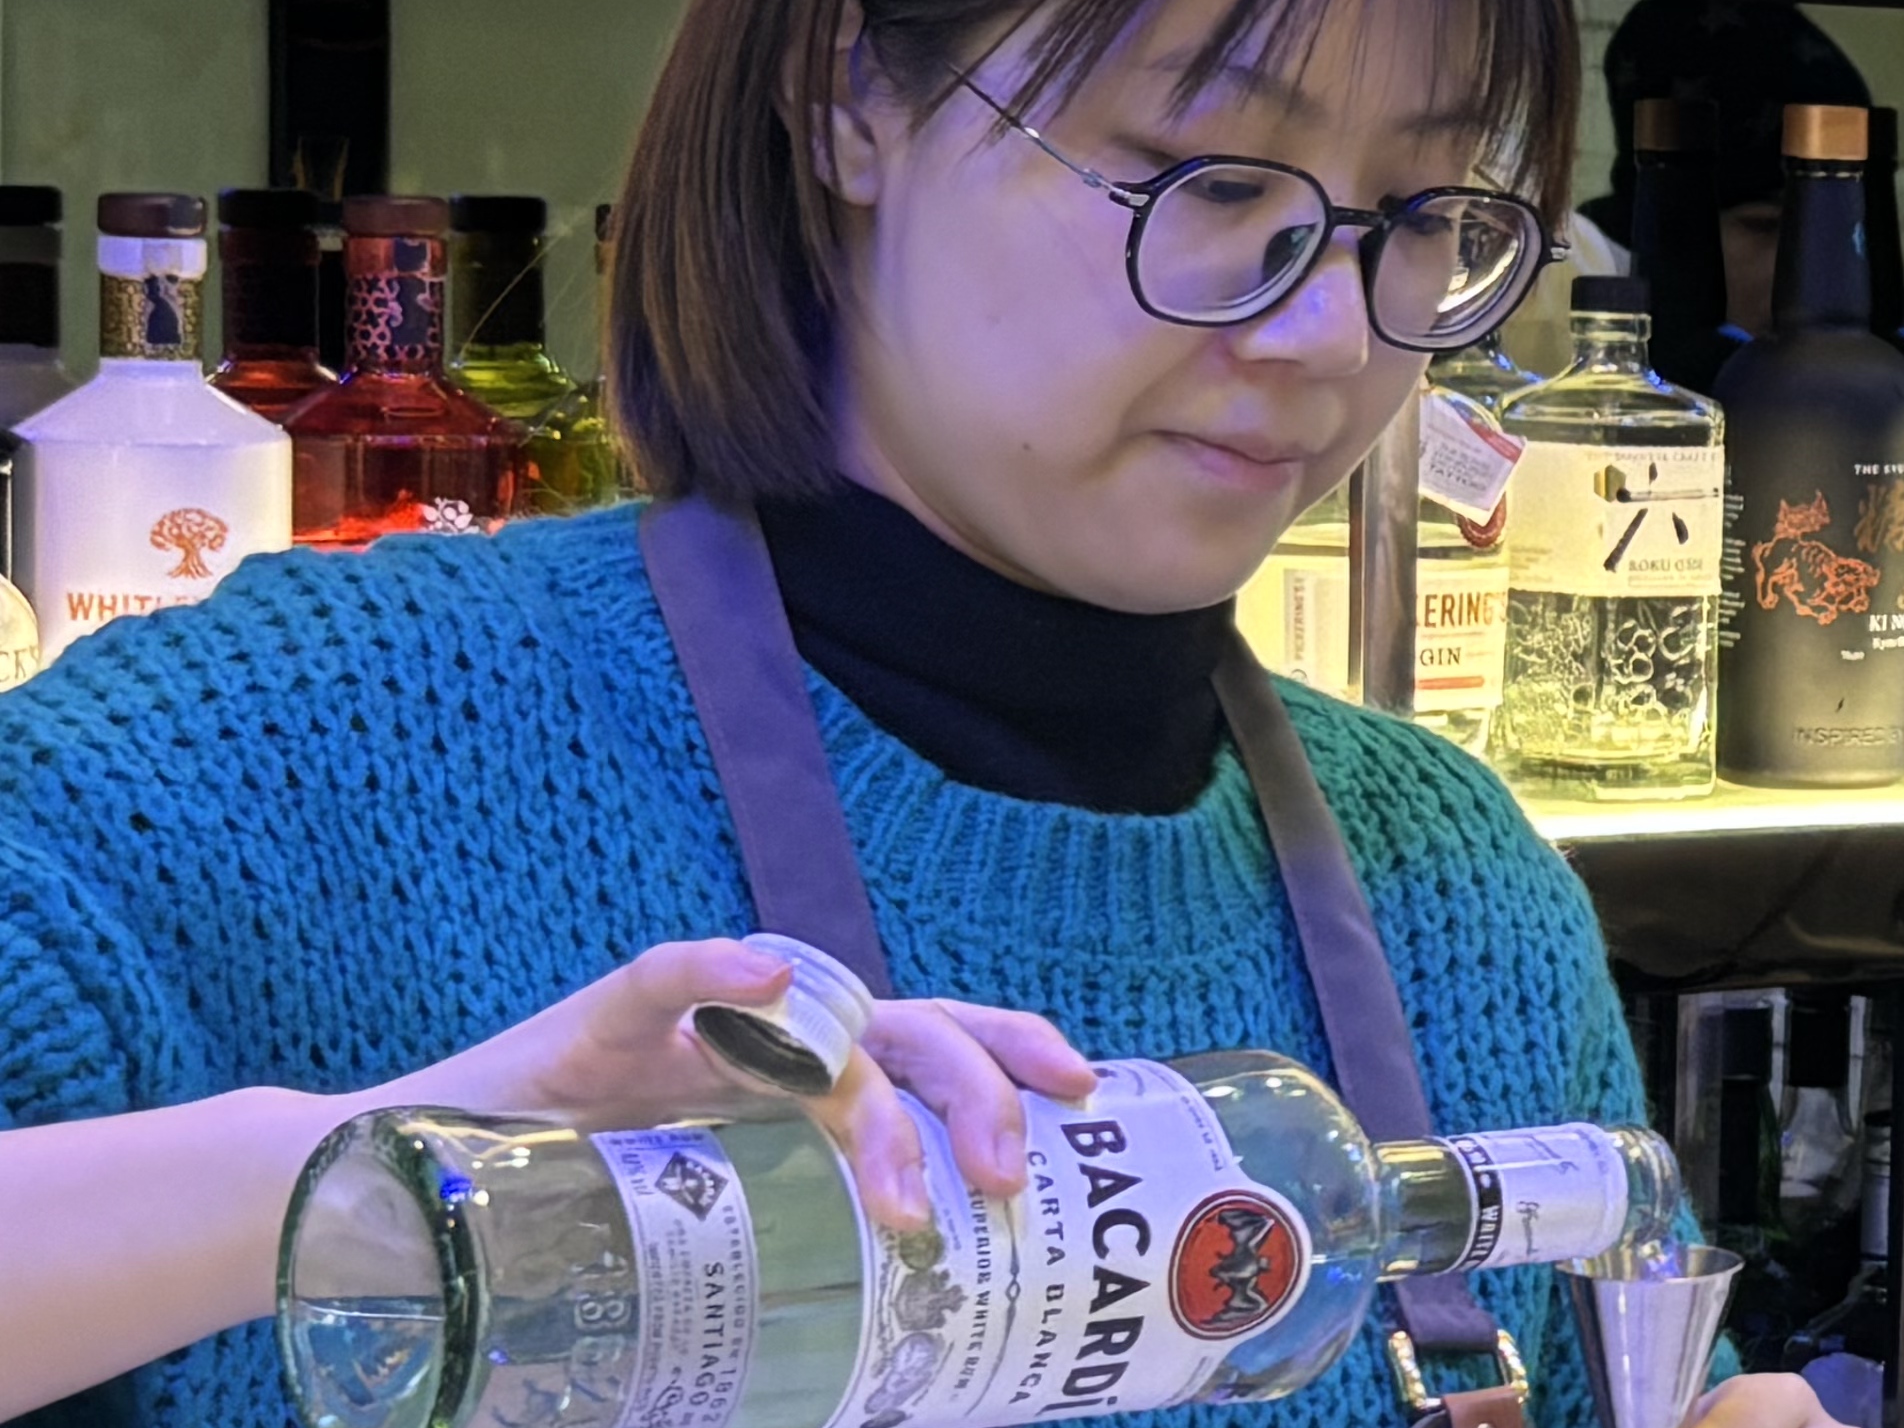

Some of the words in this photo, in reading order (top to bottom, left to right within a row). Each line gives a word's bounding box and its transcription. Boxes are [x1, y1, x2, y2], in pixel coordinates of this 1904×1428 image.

[1628, 557, 1670, 572] ROKU
[1419, 647, 1462, 667] GIN
[966, 1186, 992, 1290] SUPERIOR
[1026, 1151, 1066, 1267] CARTA
[687, 1262, 725, 1408] SANTIAGO
[972, 1290, 990, 1353] WHITE
[1008, 1283, 1067, 1407] BLANCA
[712, 1367, 738, 1424] 1862
